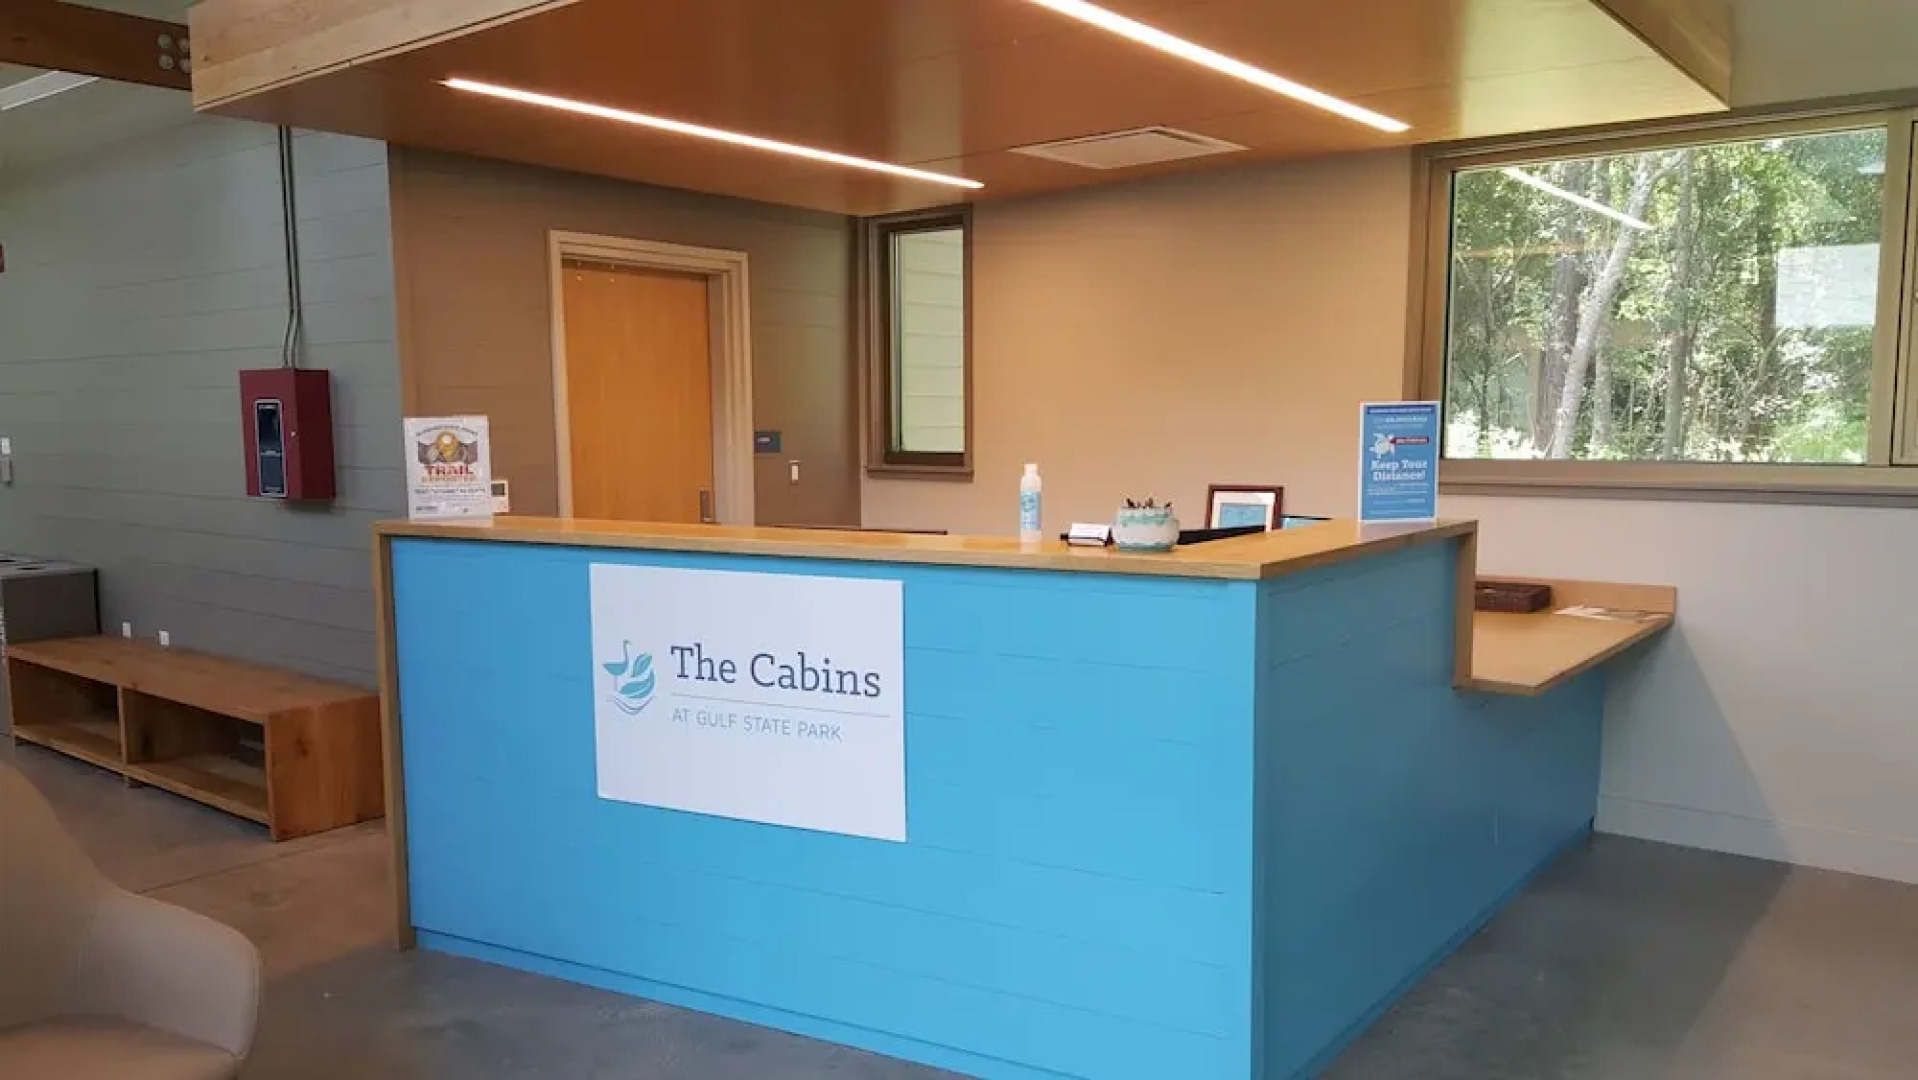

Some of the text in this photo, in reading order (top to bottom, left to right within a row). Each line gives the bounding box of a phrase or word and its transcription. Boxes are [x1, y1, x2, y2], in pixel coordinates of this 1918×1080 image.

[425, 465, 474, 475] TRAIL
[1370, 458, 1428, 470] Keep Your
[670, 642, 881, 698] The Cabins
[672, 708, 842, 741] AT GULF STATE PARK
